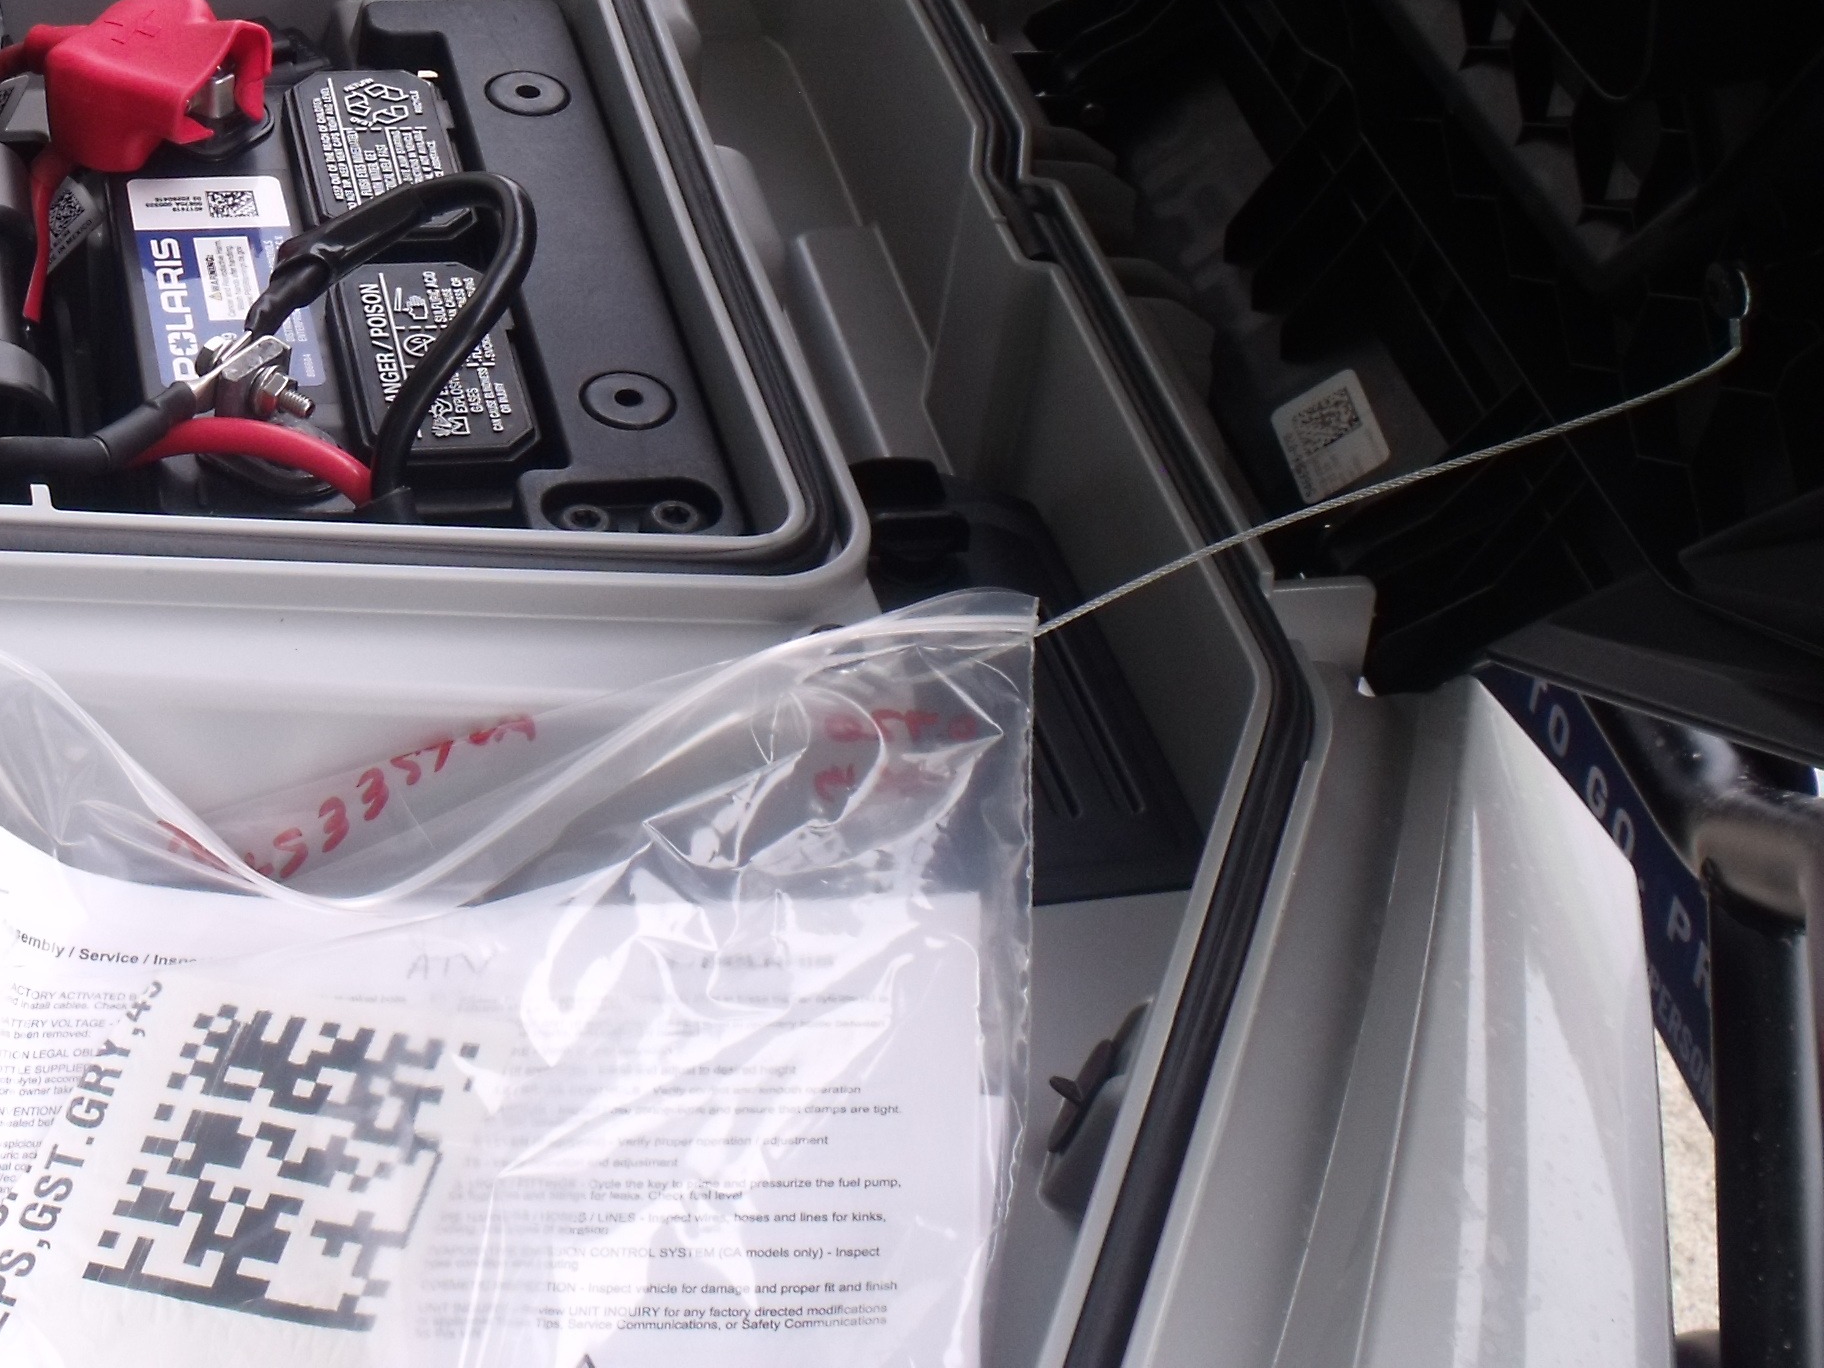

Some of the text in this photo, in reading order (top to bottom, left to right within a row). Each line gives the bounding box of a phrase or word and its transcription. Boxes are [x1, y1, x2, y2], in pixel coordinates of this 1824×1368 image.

[423, 271, 447, 323] SULFURIC ACID
[150, 238, 199, 380] POLARIS
[359, 283, 402, 403] ANGER POISON
[466, 387, 484, 413] GASES
[79, 948, 139, 964] Service
[61, 992, 125, 1000] ACTIVATED
[95, 1001, 127, 1010] Check
[51, 1019, 105, 1027] VOLTAGE
[33, 1049, 69, 1059] LEGAL
[760, 1064, 797, 1077] height
[653, 1084, 686, 1096] Verify
[805, 1084, 861, 1097] operation
[735, 1106, 775, 1115] ensure
[804, 1104, 847, 1116] clamps
[618, 1135, 650, 1147] Verify
[696, 1136, 752, 1147] operation
[763, 1135, 829, 1148] adjustment
[588, 1179, 622, 1191] Cycle
[750, 1178, 812, 1189] pressurize
[815, 1178, 834, 1187] the
[838, 1177, 861, 1187] fuel
[864, 1178, 902, 1190] pump,
[715, 1190, 743, 1200] level
[597, 1213, 636, 1223] LINES
[648, 1213, 691, 1224] Inspect
[734, 1212, 769, 1223] hoses
[774, 1212, 796, 1222] and
[800, 1212, 828, 1222] lines
[832, 1211, 849, 1222] for
[852, 1211, 886, 1223] kinks,
[590, 1247, 656, 1258] CONTROL
[659, 1247, 715, 1258] SYSTEM
[746, 1247, 789, 1258] models
[793, 1247, 823, 1260] only)
[835, 1247, 881, 1258] Inspect
[588, 1283, 631, 1294] Inspect
[635, 1283, 678, 1294] vehicle
[681, 1283, 697, 1294] for
[700, 1283, 749, 1296] damage
[754, 1283, 777, 1294] and
[781, 1283, 819, 1295] proper
[839, 1282, 862, 1292] and
[865, 1281, 897, 1291] finish
[569, 1304, 888, 1319] UNIT INQUIRY for any factory directed modifications
[568, 1319, 612, 1329] Service
[617, 1318, 721, 1330] Communications,
[742, 1318, 780, 1332] Safety
[784, 1316, 887, 1329] Communications
